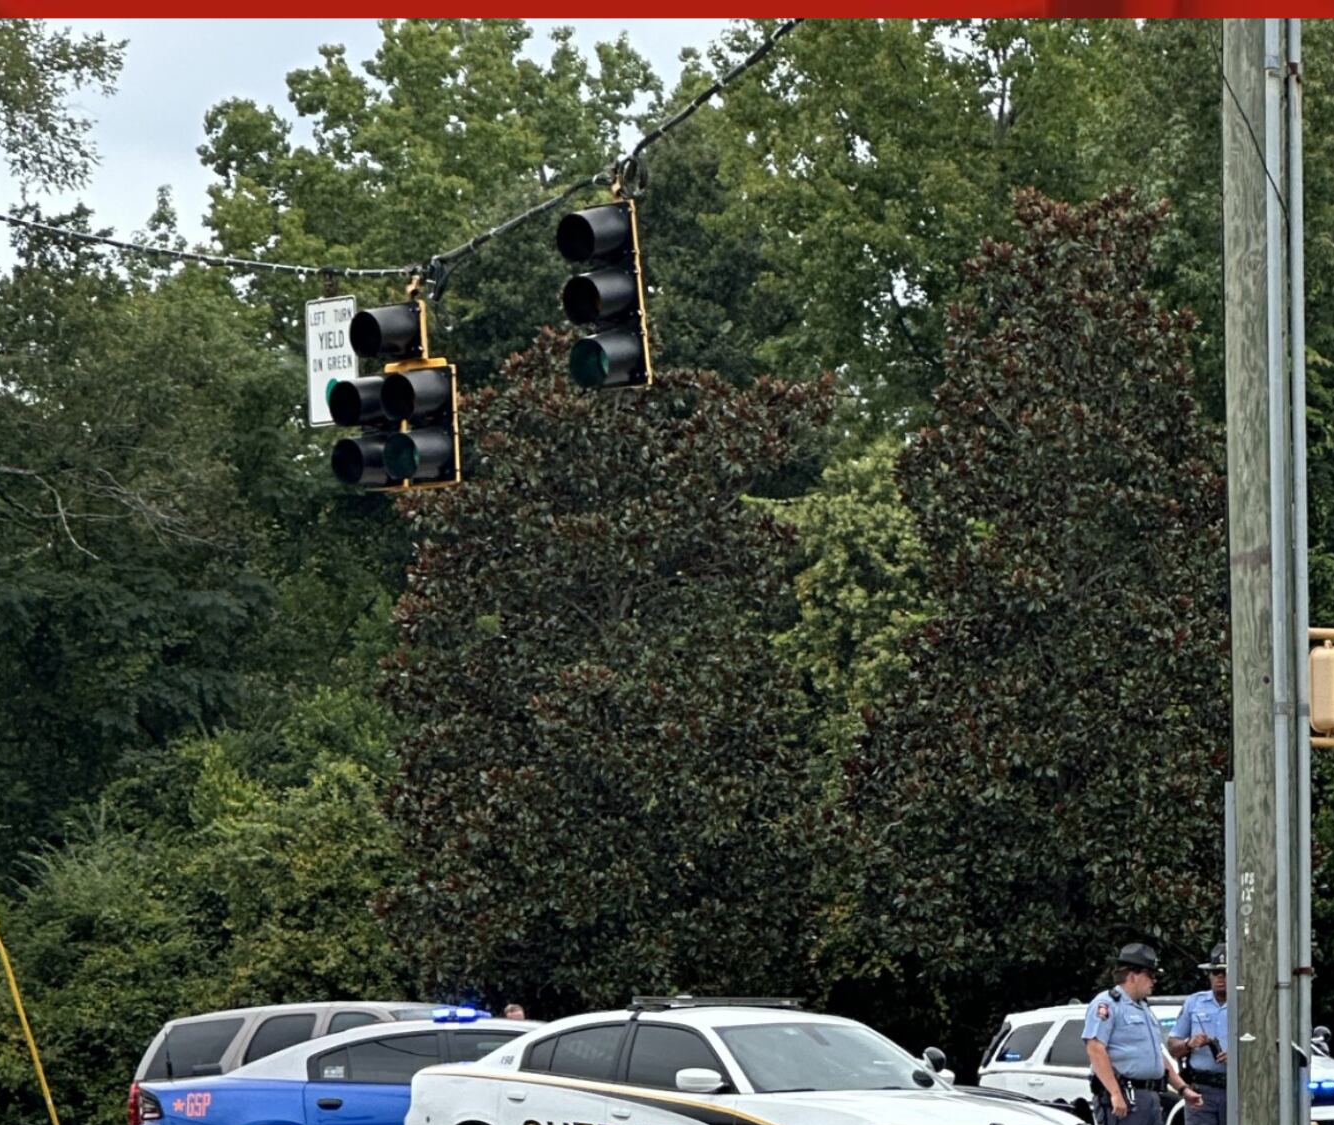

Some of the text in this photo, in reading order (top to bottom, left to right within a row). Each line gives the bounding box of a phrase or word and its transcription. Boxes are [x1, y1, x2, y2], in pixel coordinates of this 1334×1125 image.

[310, 308, 352, 326] LEFT TURN
[318, 330, 344, 350] YIELD
[313, 355, 352, 372] ON GREEN
[186, 1092, 211, 1117] GSP
